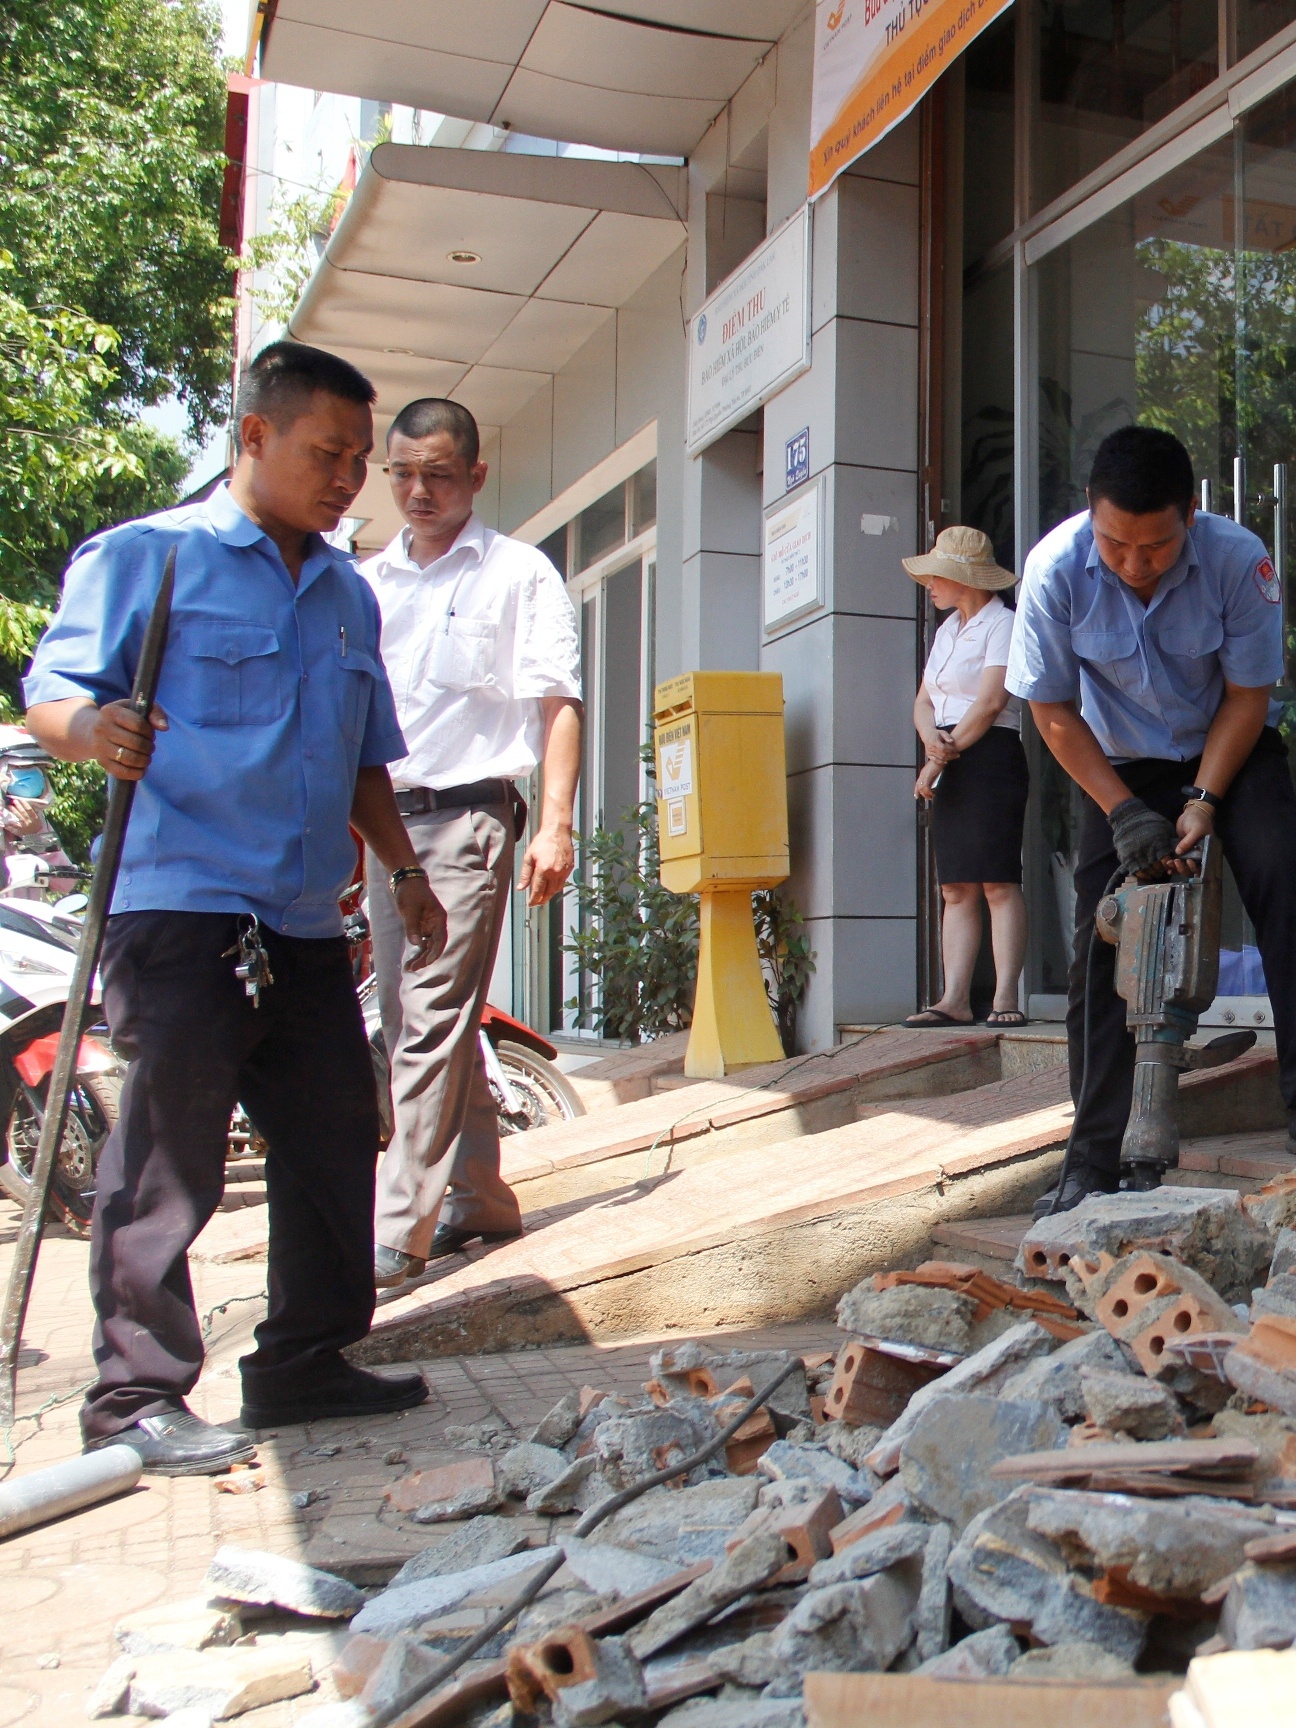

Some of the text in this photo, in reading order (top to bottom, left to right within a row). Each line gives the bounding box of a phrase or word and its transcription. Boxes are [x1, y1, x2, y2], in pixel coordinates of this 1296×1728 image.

[885, 0, 928, 46] THỦ TỤ
[892, 77, 902, 99] hệ
[904, 64, 914, 87] tại
[916, 42, 936, 74] điểm
[939, 24, 956, 56] giao
[958, 1, 975, 29] dịch
[723, 309, 744, 344] ĐIỂM
[747, 287, 766, 321] THU
[788, 436, 806, 471] 175
